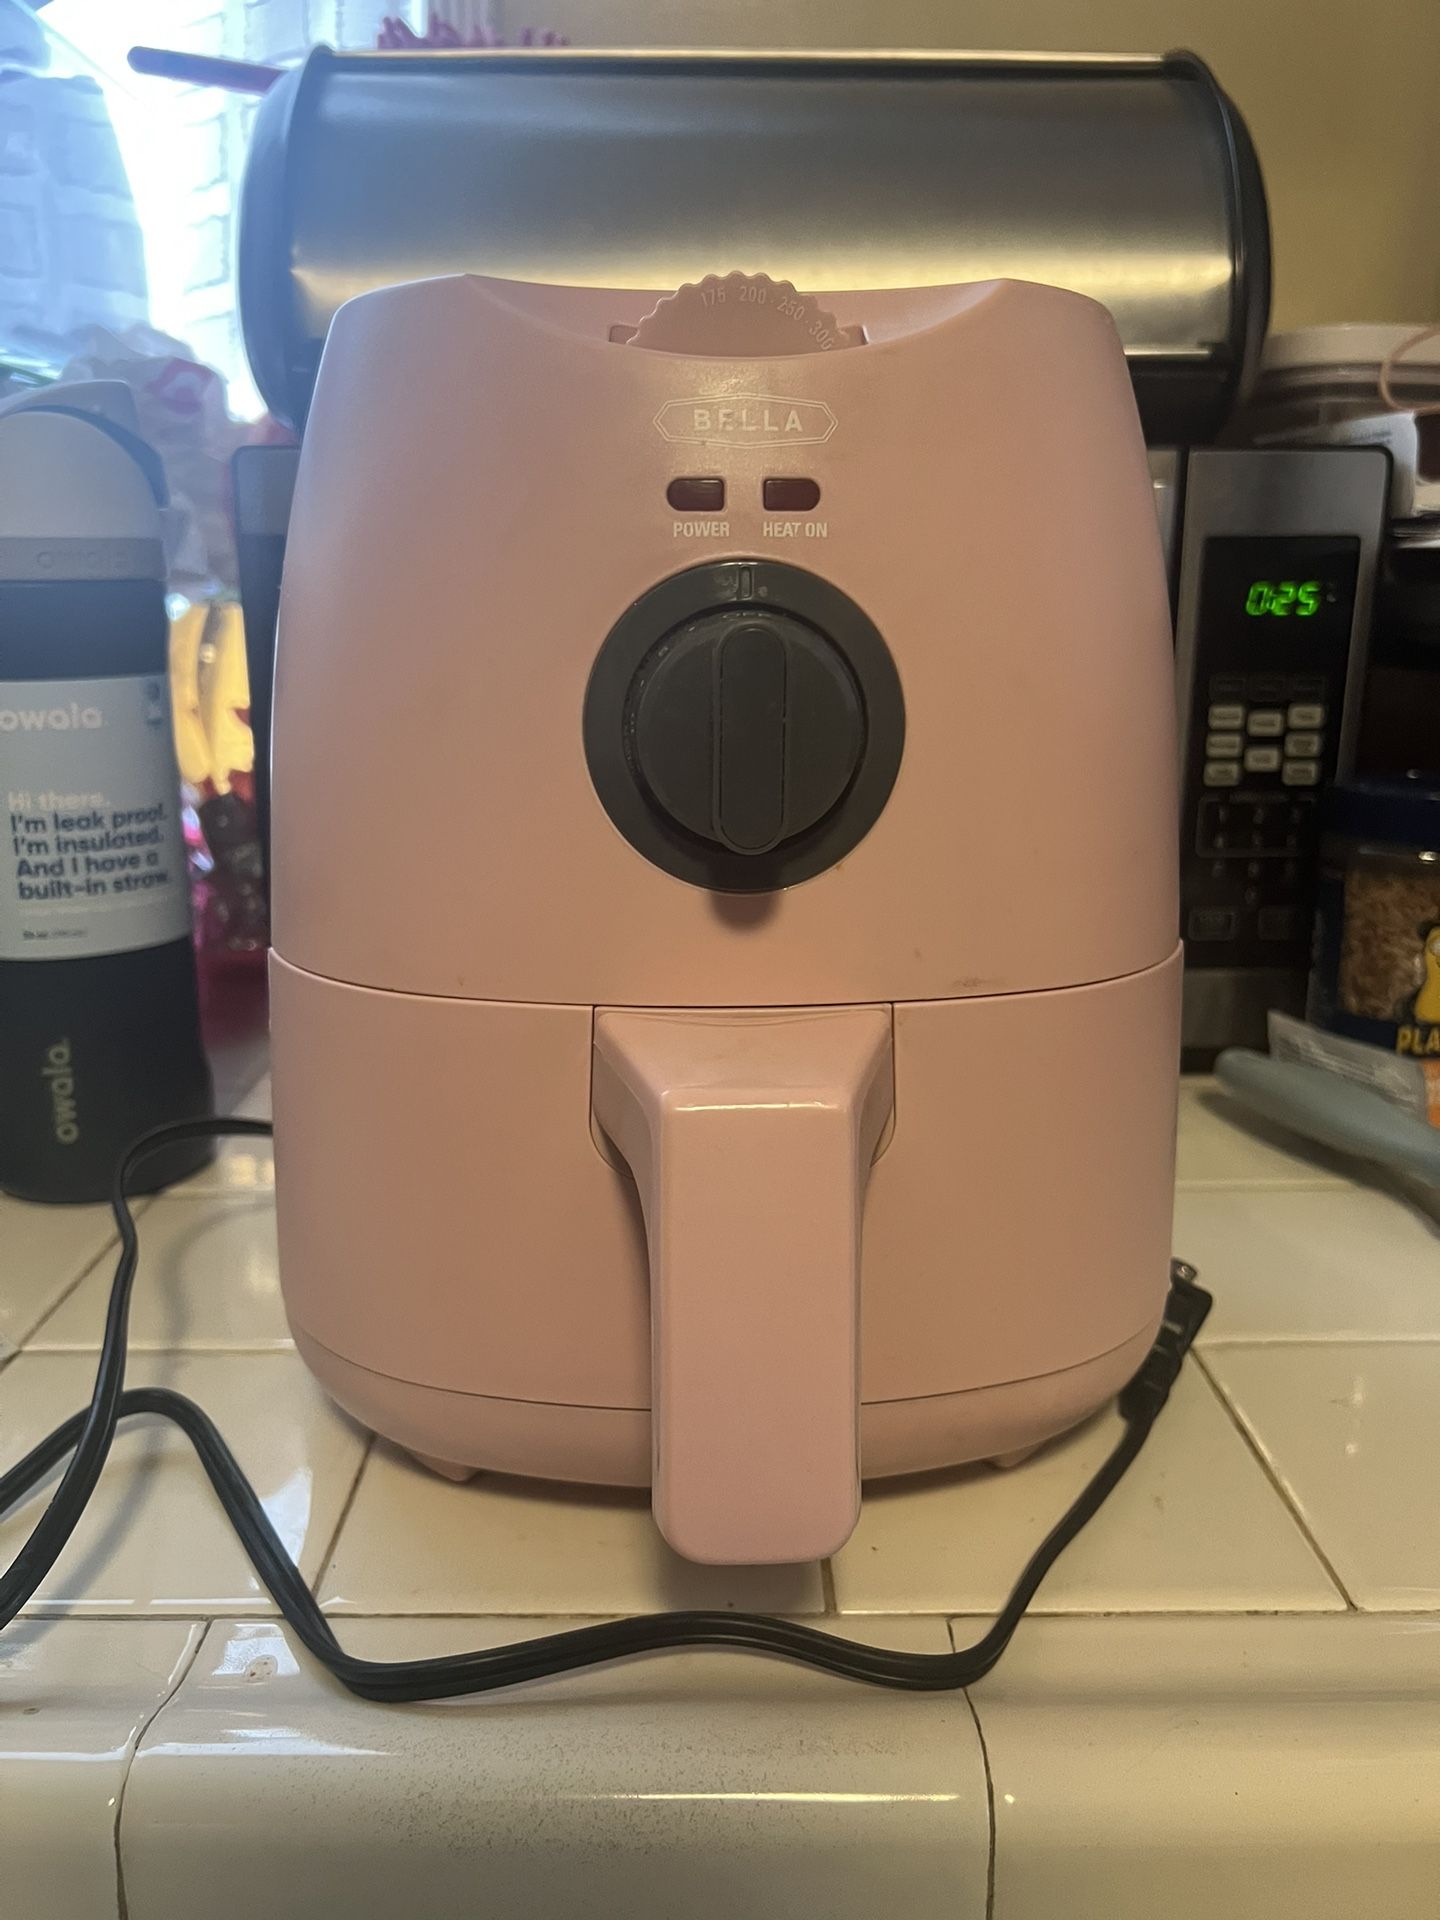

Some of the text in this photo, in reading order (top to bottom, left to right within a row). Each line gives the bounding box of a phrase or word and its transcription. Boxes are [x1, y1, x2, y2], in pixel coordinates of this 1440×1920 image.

[739, 286, 767, 304] 200
[776, 296, 805, 321] 250
[693, 408, 803, 432] BELLA
[673, 521, 730, 537] POWER
[763, 521, 828, 537] HEAT ON
[11, 812, 47, 834] I'm
[53, 809, 105, 832] leak
[13, 835, 48, 857] I'm
[17, 851, 158, 878] And I have a
[18, 878, 107, 900] built-in
[42, 1037, 79, 1144] owala
